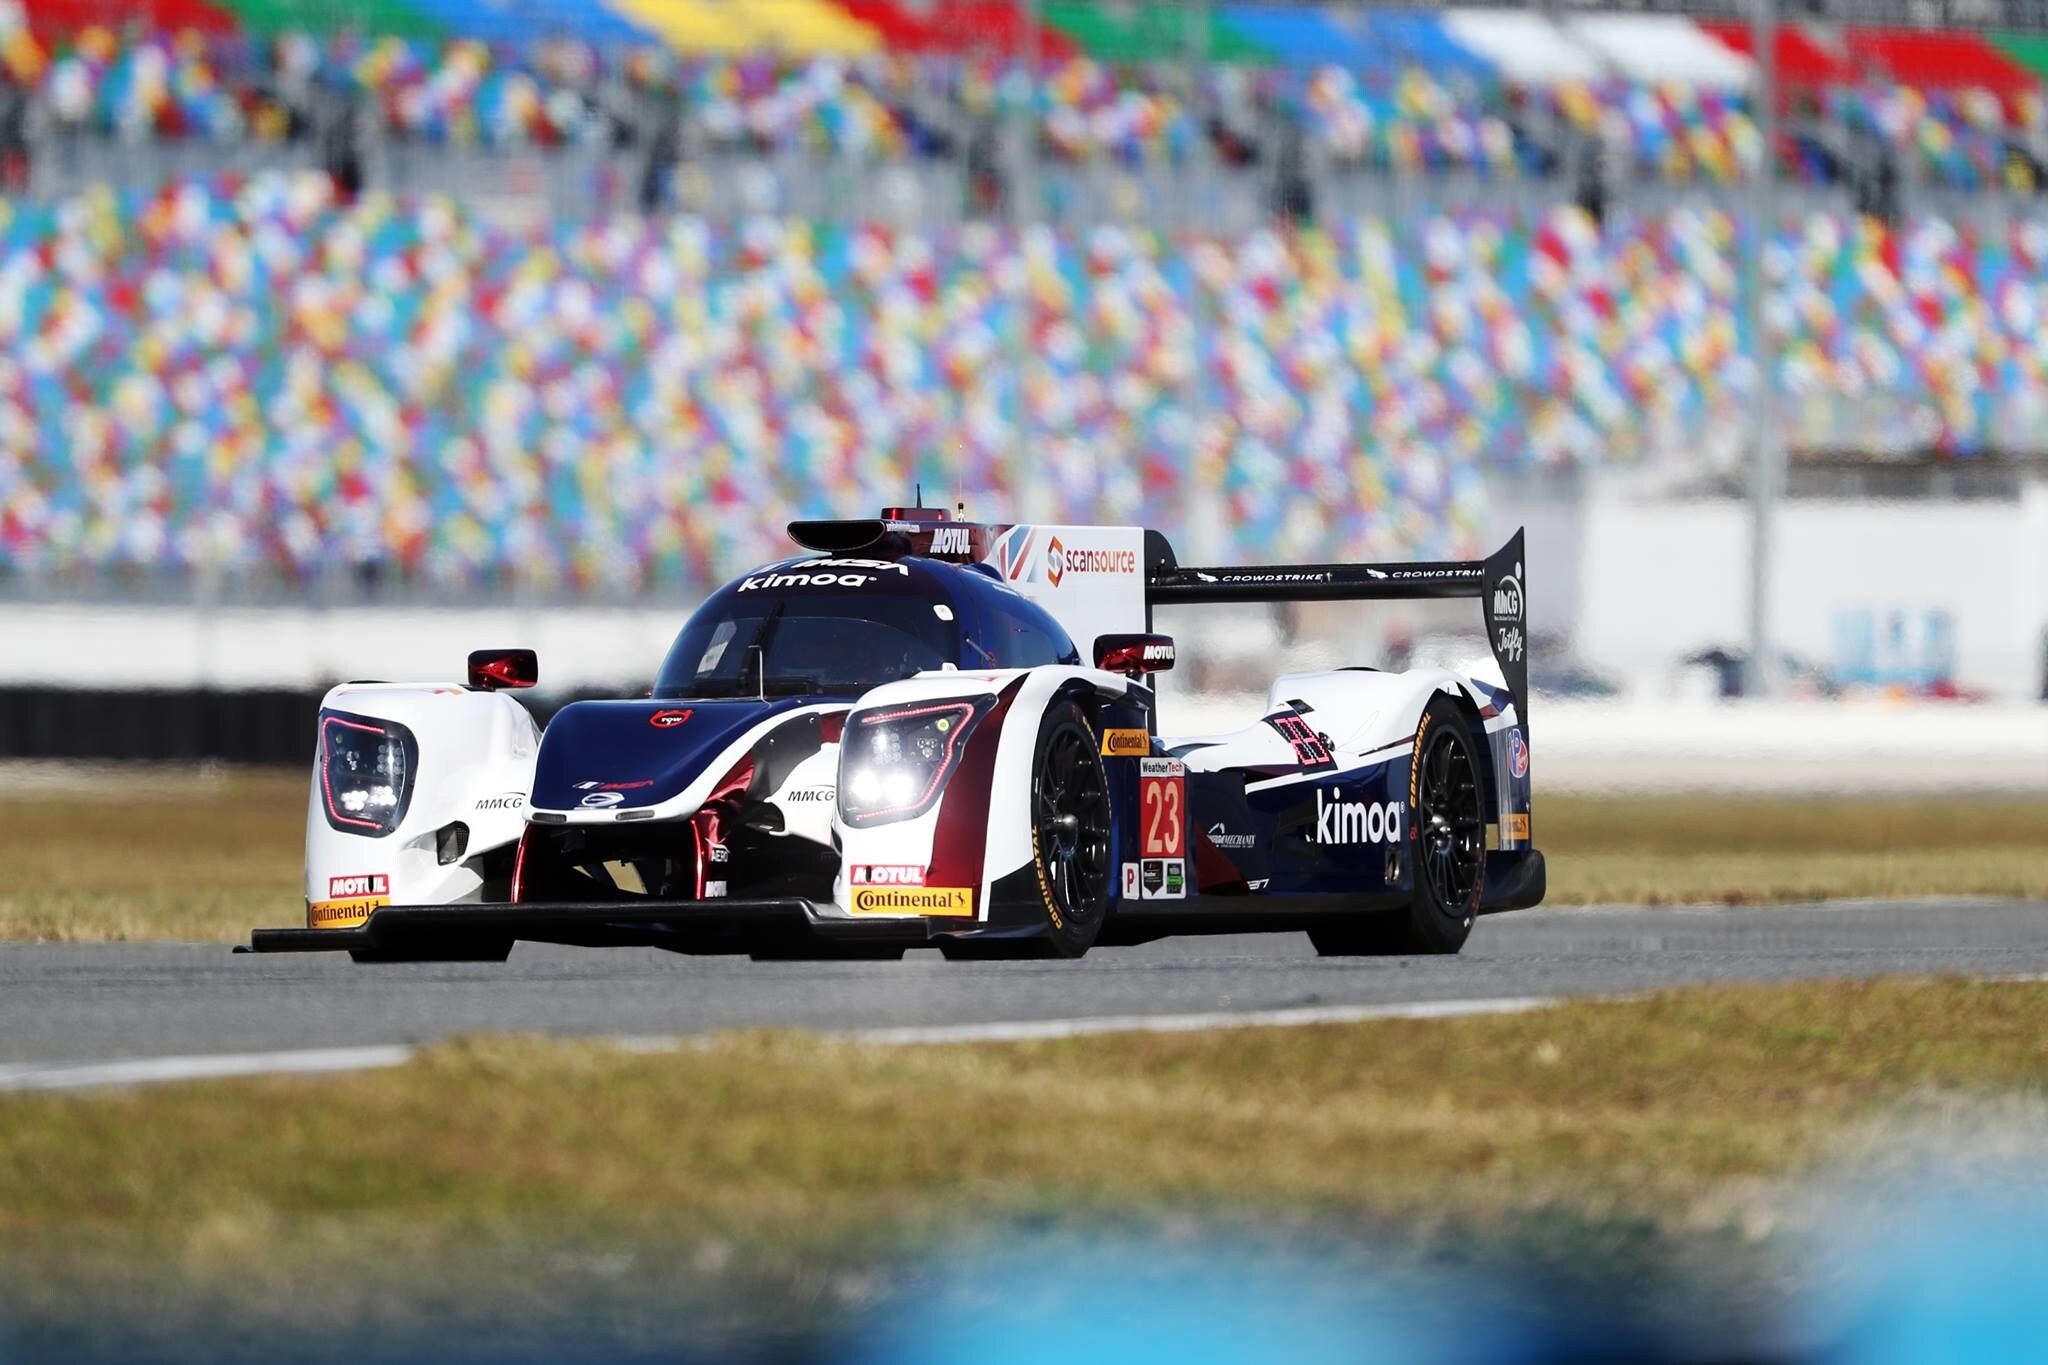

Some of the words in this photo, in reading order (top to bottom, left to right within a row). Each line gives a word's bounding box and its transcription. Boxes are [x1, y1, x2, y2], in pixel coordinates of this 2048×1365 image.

[930, 528, 971, 554] MOTUL
[1065, 549, 1135, 573] scansource
[737, 573, 868, 593] kimoa
[1222, 573, 1323, 582] CROWDSTRIKE
[1143, 645, 1174, 660] MOTUL
[1498, 626, 1523, 662] Jetfly
[1107, 732, 1142, 753] Continental
[1142, 762, 1184, 773] WeatherTech
[475, 798, 522, 810] MMCG
[787, 790, 835, 802] MMCG
[1146, 781, 1180, 855] 23
[1316, 787, 1401, 845] kimoa
[850, 866, 923, 883] MOTUL
[1126, 868, 1135, 894] P
[857, 890, 952, 911] Continental
[311, 901, 371, 927] Continental
